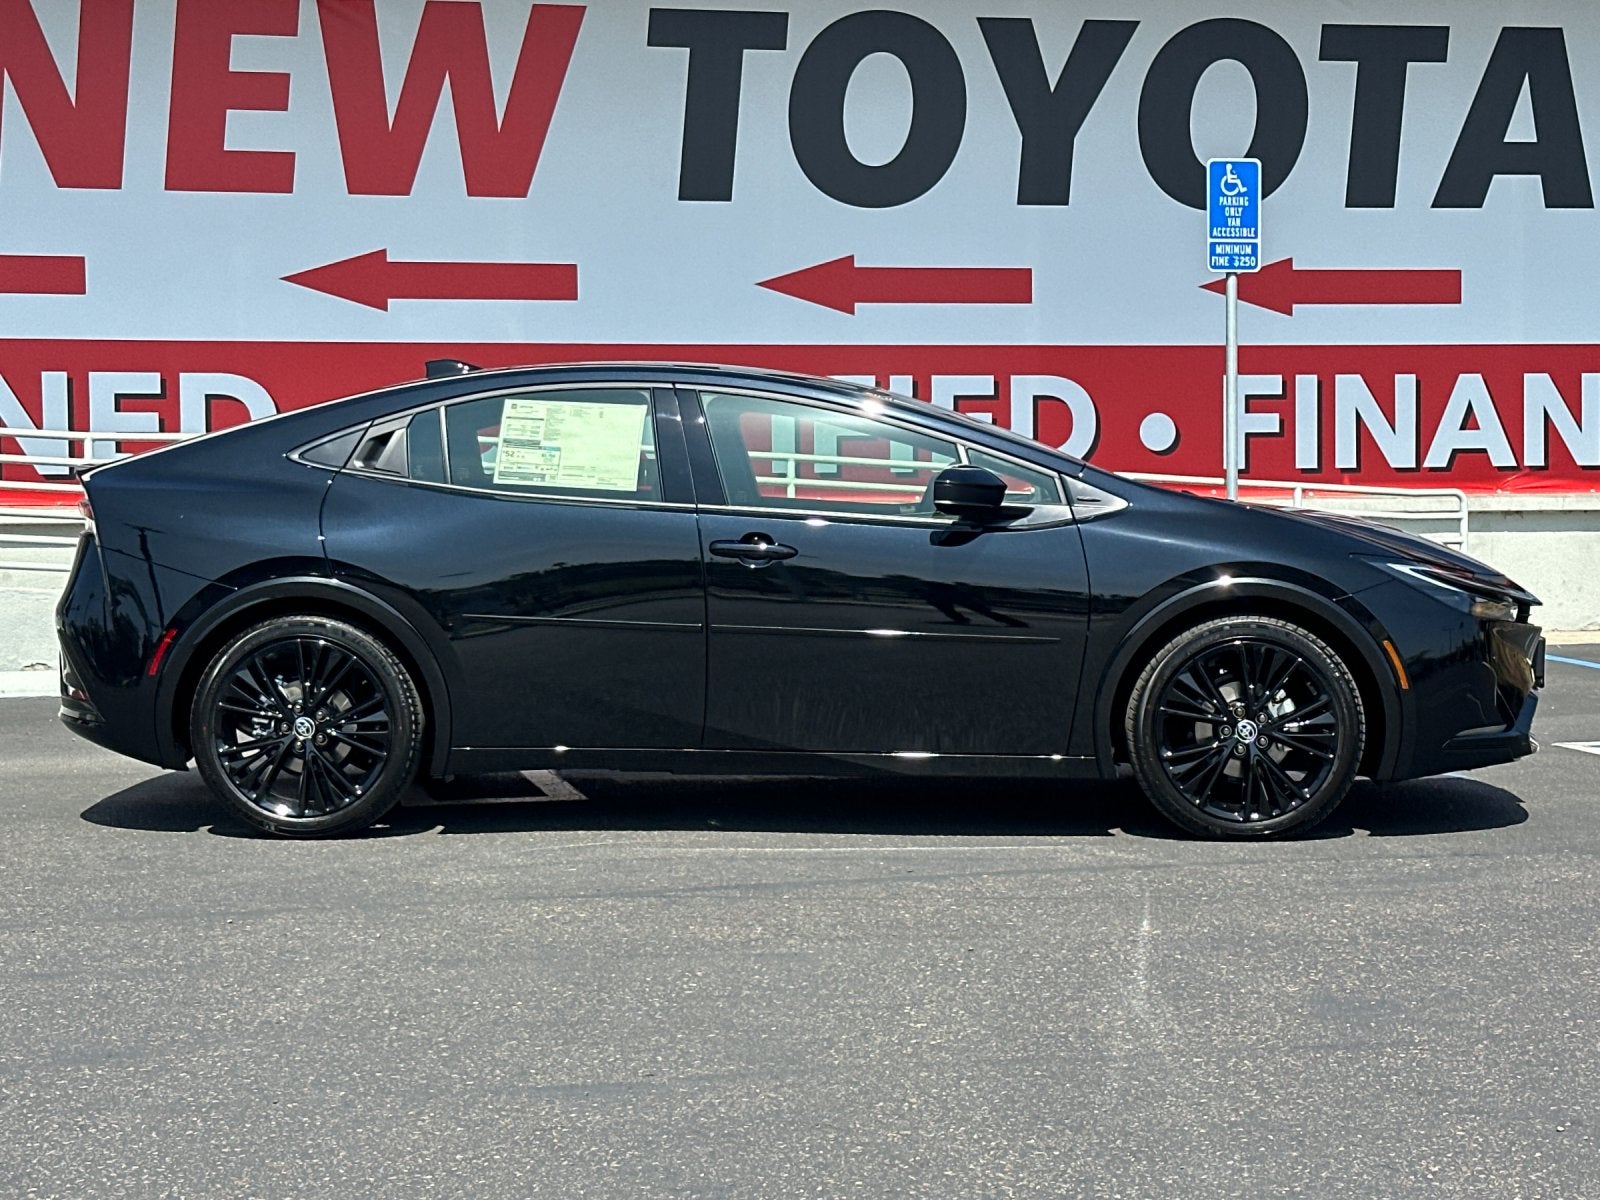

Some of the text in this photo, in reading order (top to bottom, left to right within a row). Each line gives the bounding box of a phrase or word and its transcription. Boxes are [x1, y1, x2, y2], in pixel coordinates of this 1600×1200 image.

[0, 0, 1596, 209] NEW TOYOTA
[1219, 196, 1249, 206] PARKING
[1225, 207, 1243, 216] ONLY
[1228, 217, 1241, 227] VAN
[1212, 227, 1256, 237] ACCESSIBLE
[1215, 244, 1252, 255] MINIMUM
[1211, 256, 1256, 267] FINE $250
[1223, 372, 1600, 470] FINAN
